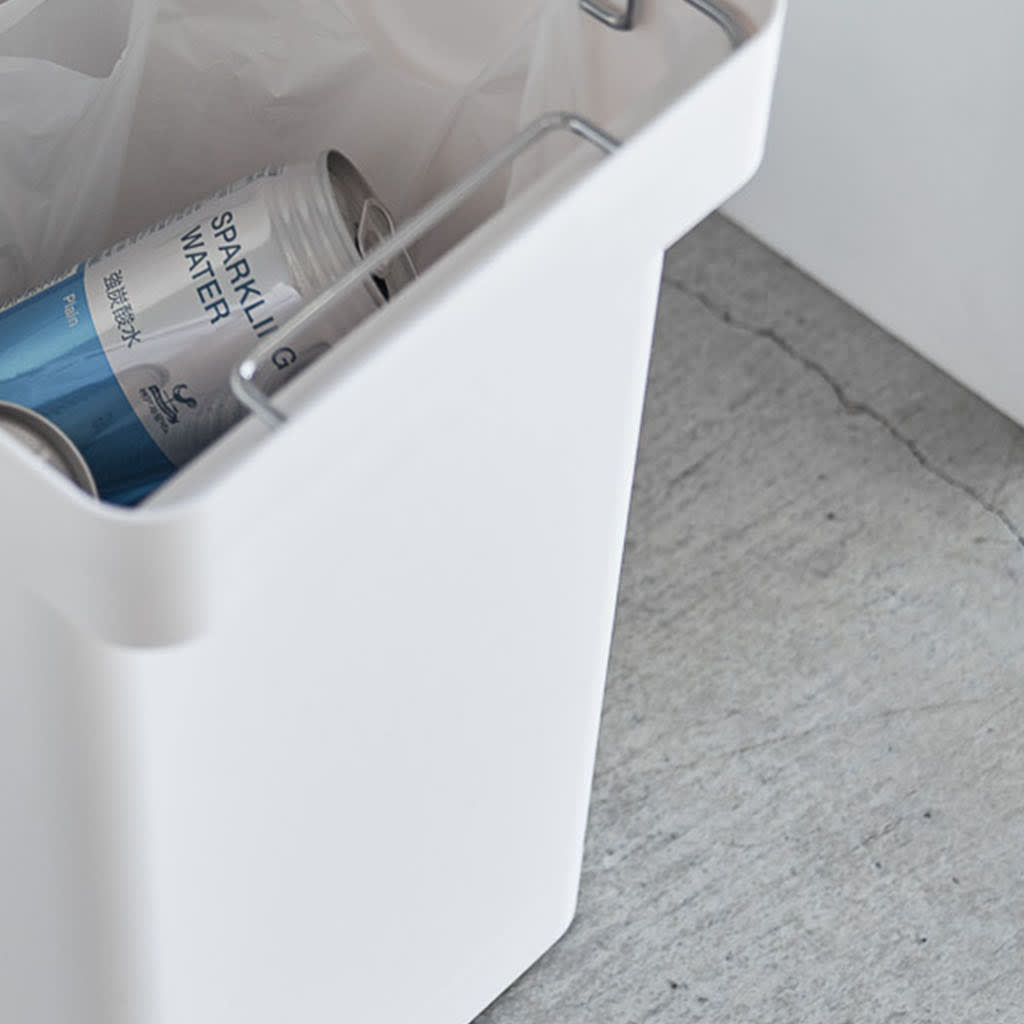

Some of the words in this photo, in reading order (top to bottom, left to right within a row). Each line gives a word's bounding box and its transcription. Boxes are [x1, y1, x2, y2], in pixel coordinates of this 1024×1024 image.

[63, 293, 79, 328] Plain
[103, 269, 141, 348] 強炭酸水
[180, 225, 230, 324] WATER
